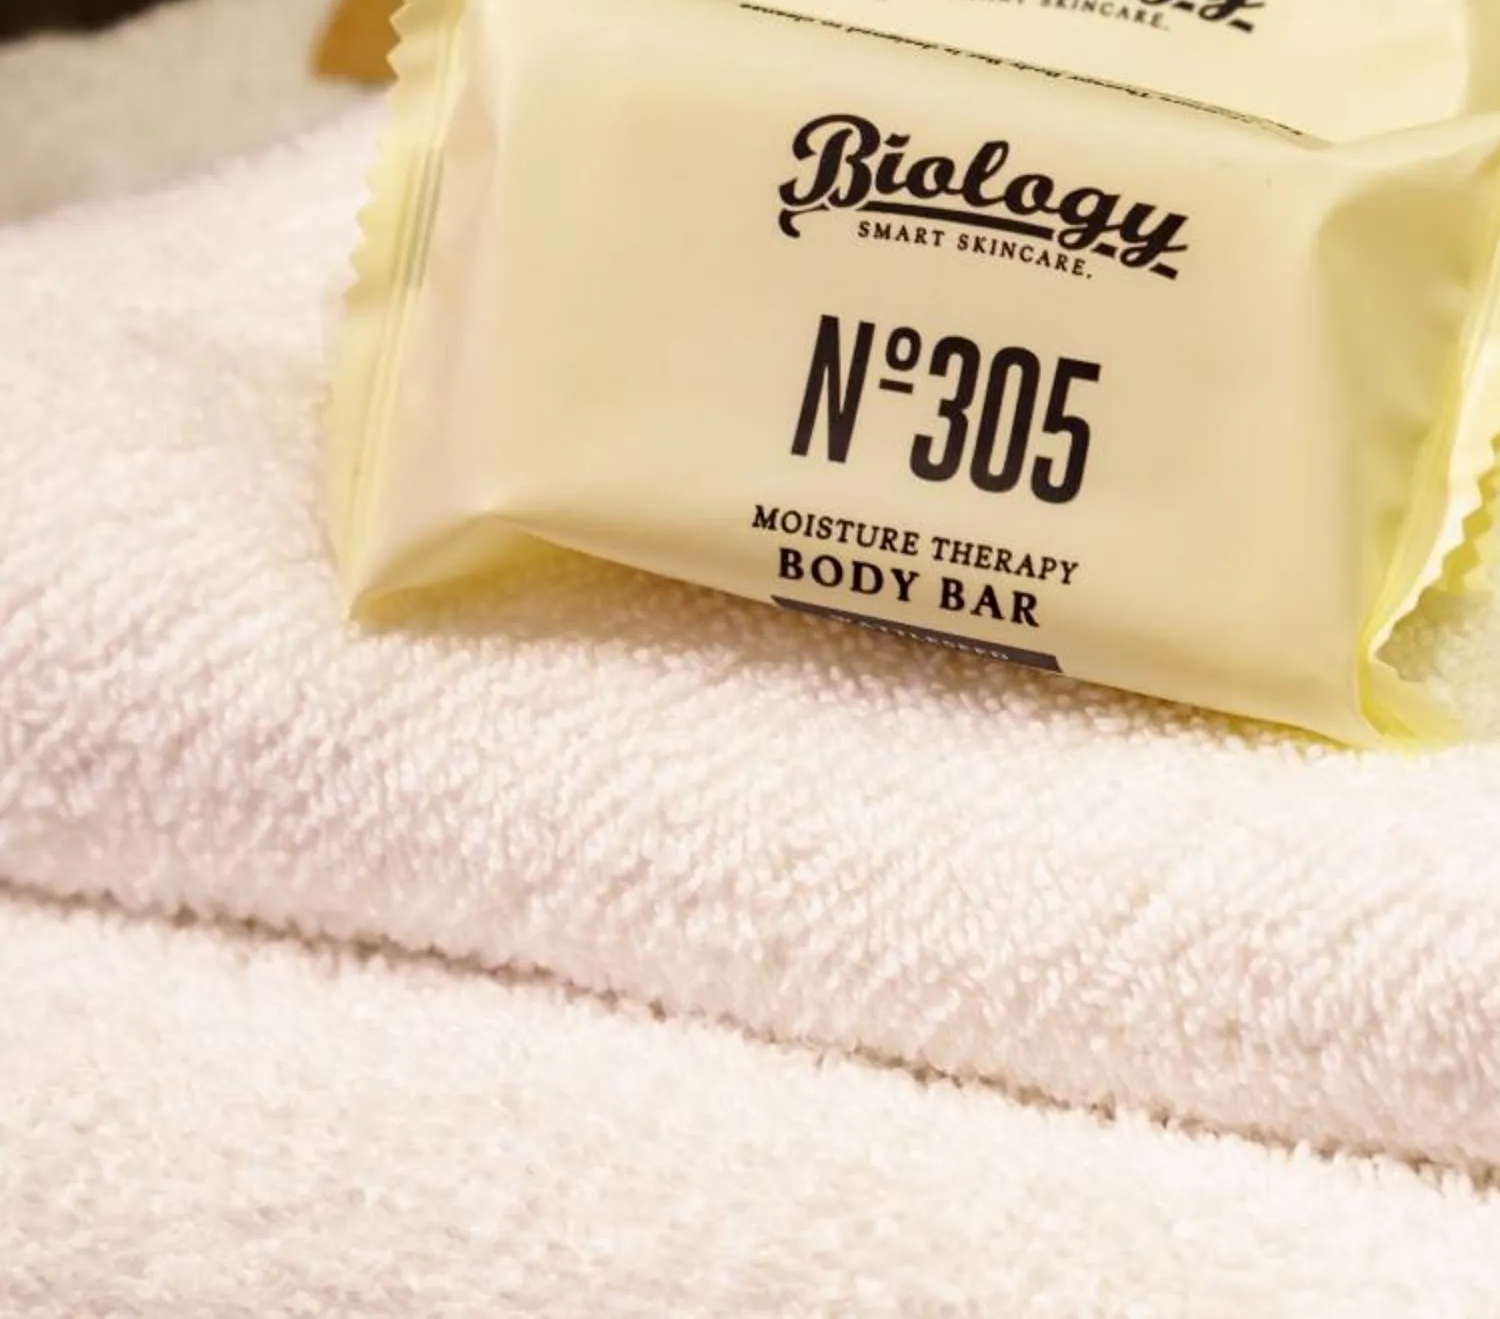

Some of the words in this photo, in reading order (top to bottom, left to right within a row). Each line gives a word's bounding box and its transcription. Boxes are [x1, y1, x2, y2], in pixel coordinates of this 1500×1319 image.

[778, 114, 1188, 280] Biology
[858, 221, 946, 247] SMART
[956, 232, 1094, 279] SKINCARE.
[751, 505, 920, 556] MOISTURE
[931, 536, 1079, 585] THERAPY
[778, 548, 921, 603] BODY
[940, 579, 1041, 628] BAR
